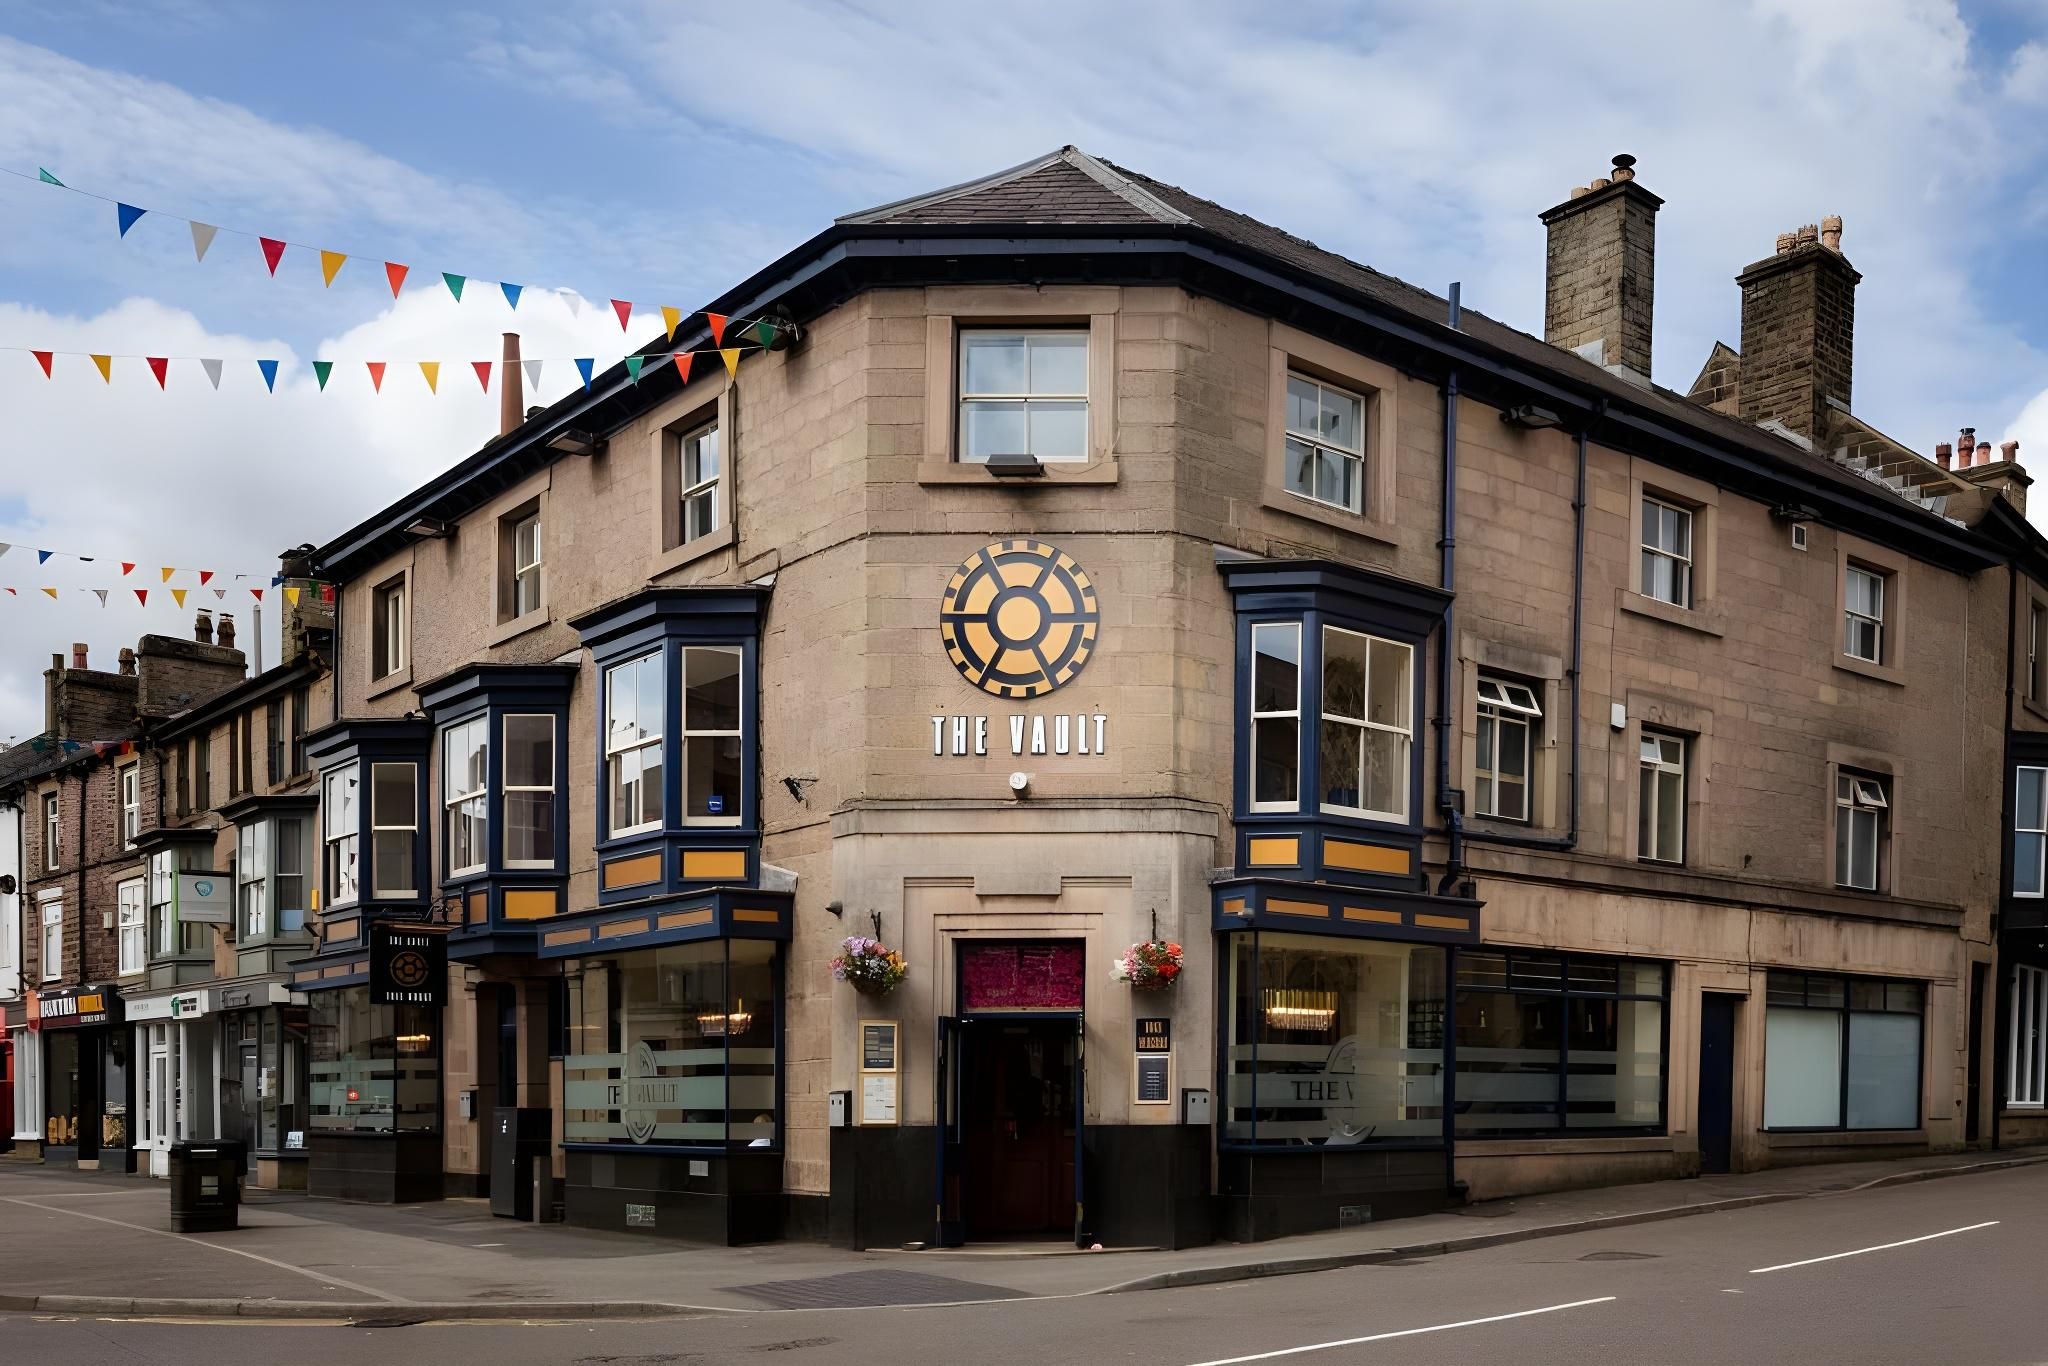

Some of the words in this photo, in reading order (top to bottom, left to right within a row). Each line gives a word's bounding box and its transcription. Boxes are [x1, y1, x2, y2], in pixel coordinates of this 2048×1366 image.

[932, 716, 988, 756] THE
[1009, 714, 1108, 756] VAULT
[1291, 1080, 1340, 1101] THE
